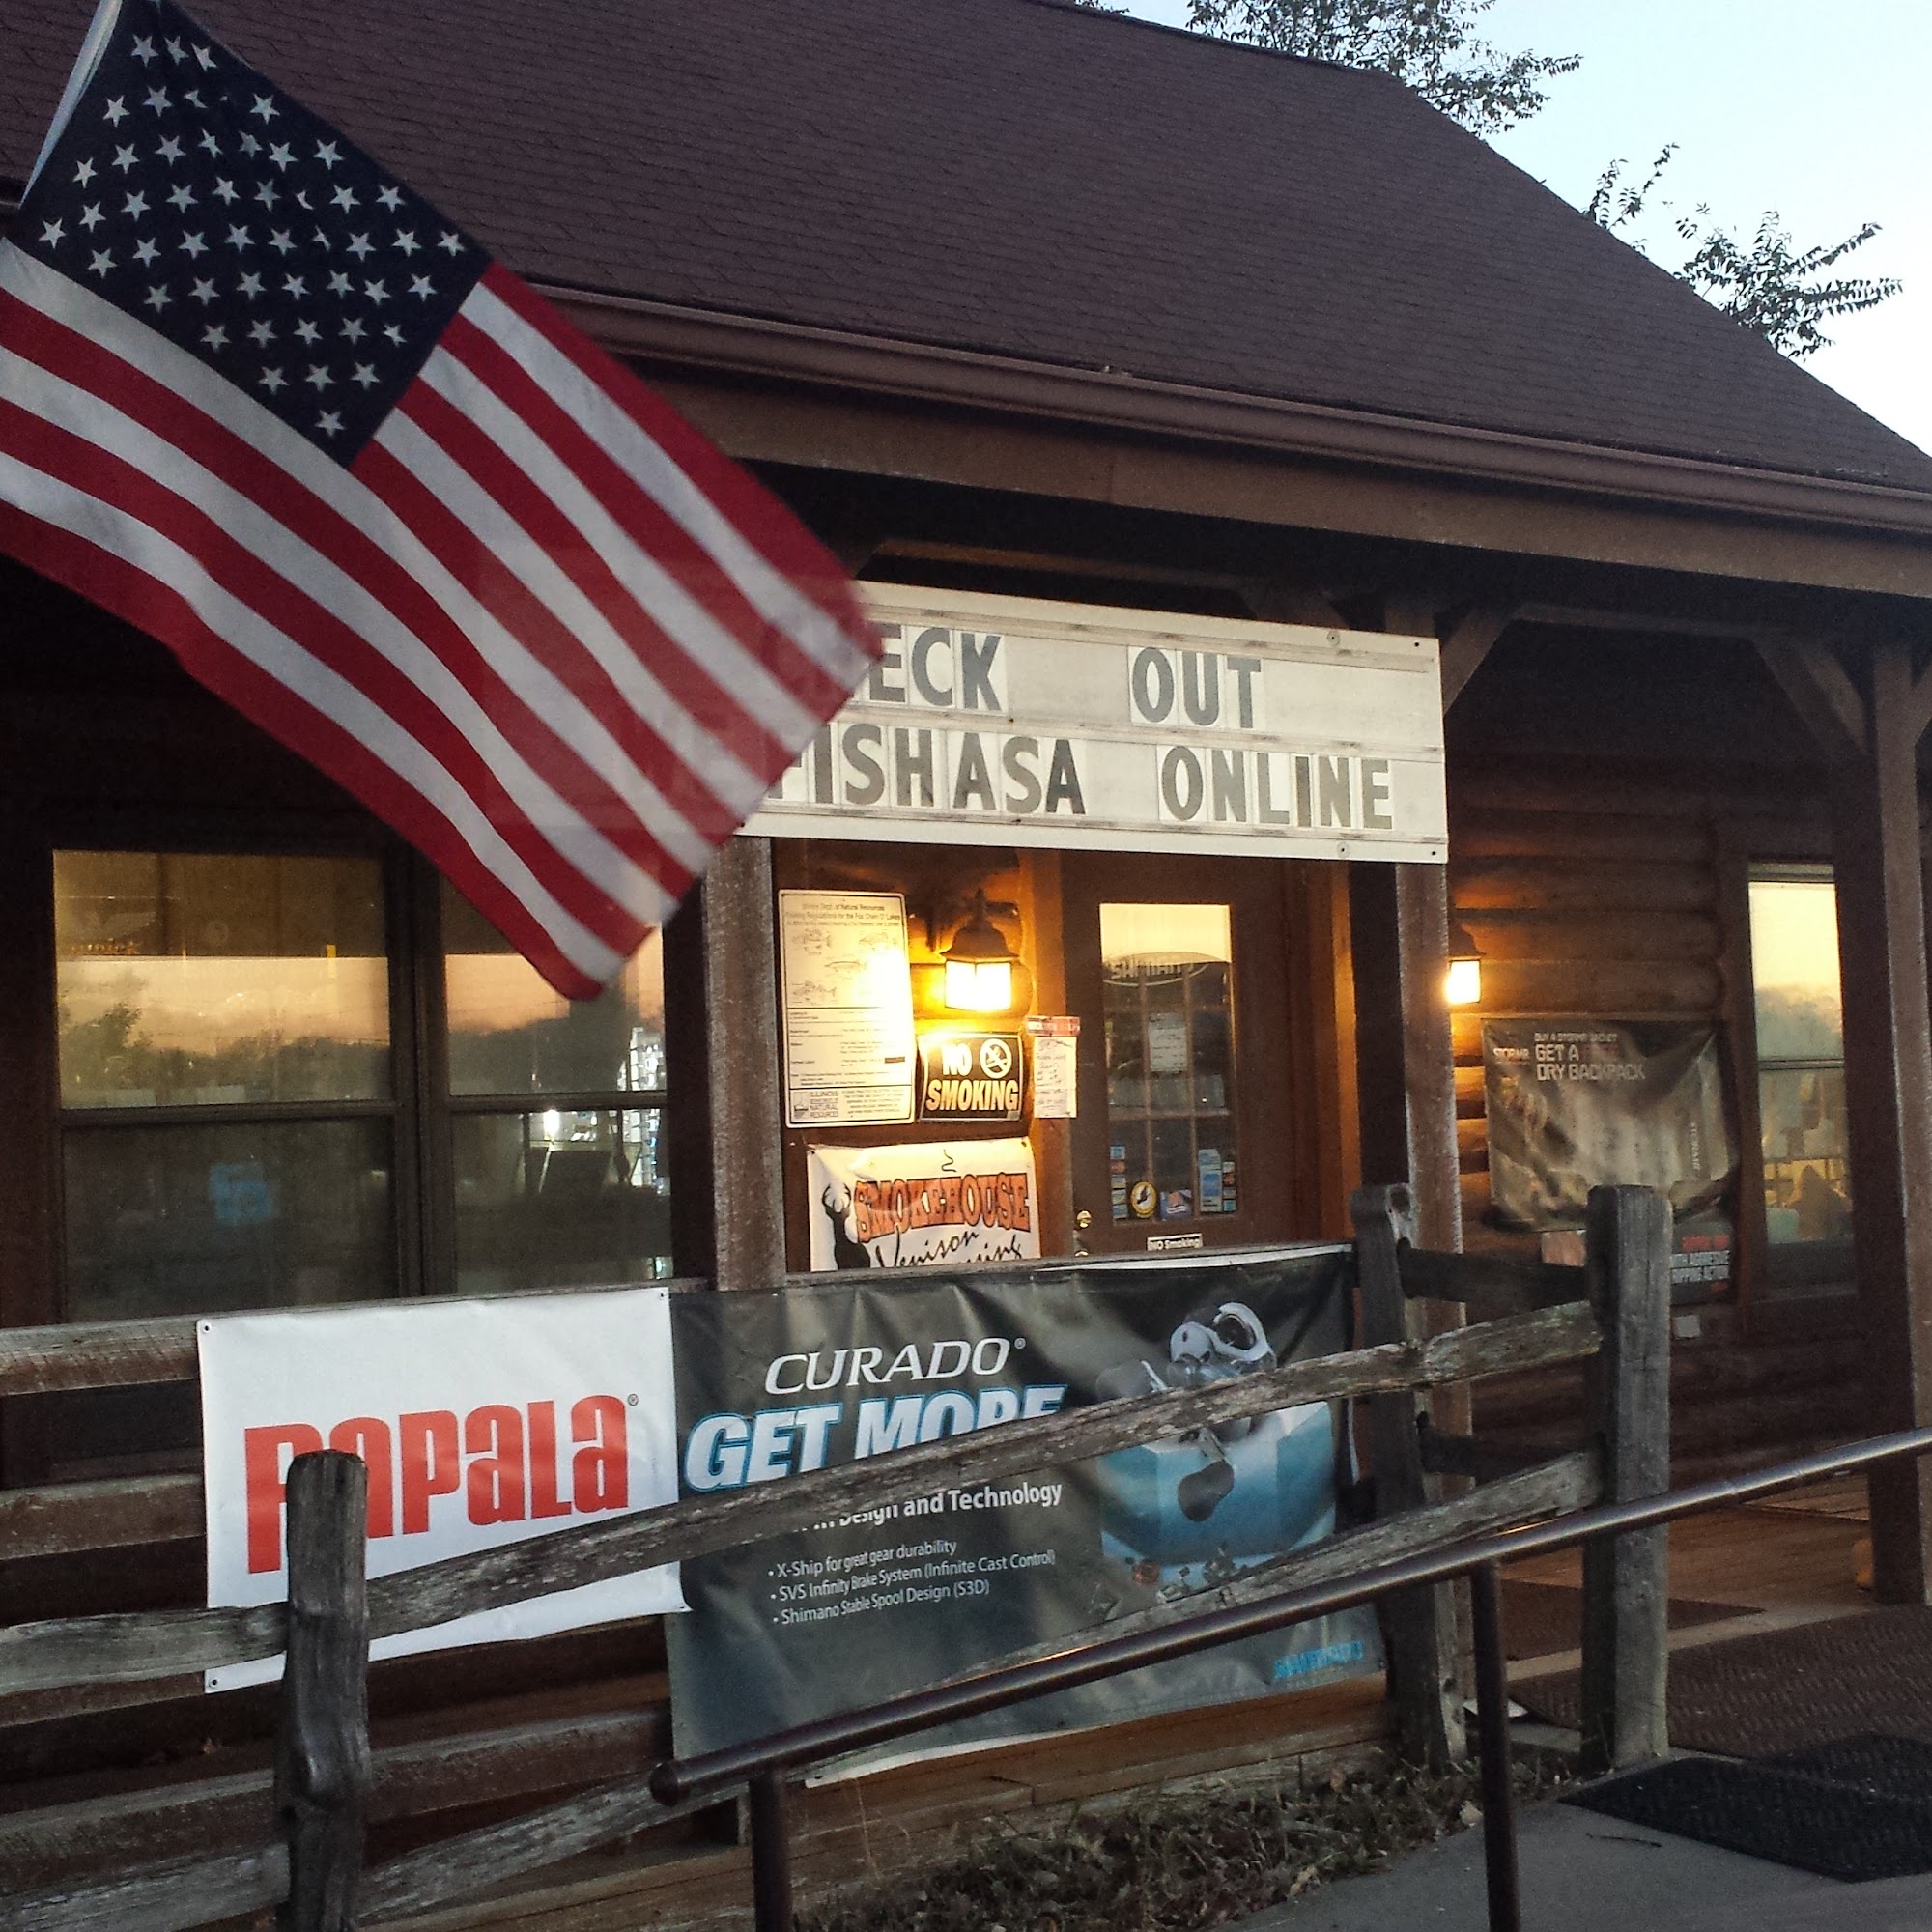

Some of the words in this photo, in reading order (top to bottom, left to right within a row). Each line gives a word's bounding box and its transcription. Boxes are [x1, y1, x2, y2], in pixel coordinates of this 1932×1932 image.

[868, 622, 1002, 712] ECK
[1132, 646, 1262, 729] OUT
[769, 722, 1086, 815] ISHASA
[1162, 746, 1393, 830] ONLINE
[942, 1041, 973, 1076] NO
[1534, 1043, 1565, 1062] GET
[1568, 1043, 1580, 1062] A
[1536, 1063, 1566, 1081] DRY
[925, 1078, 1019, 1111] SMOKING
[854, 1172, 1031, 1244] SMOKEHOUSE
[764, 1337, 1011, 1395] CURADO
[682, 1402, 843, 1493] GET
[903, 1493, 944, 1517] and
[947, 1481, 1063, 1511] Technology
[776, 1559, 824, 1579] X-Ship
[825, 1556, 843, 1572] for
[843, 1551, 869, 1572] great
[869, 1548, 895, 1568] gear
[895, 1538, 958, 1560] durability
[778, 1585, 807, 1602] SVS
[809, 1578, 851, 1598] Infinity
[851, 1572, 878, 1589] Brake
[878, 1567, 923, 1587] System
[923, 1560, 976, 1579] (Infinite
[978, 1554, 1009, 1573] Cast
[1009, 1548, 1056, 1569] Control)
[781, 1605, 839, 1626] Shimano
[840, 1598, 871, 1616] Stable
[871, 1592, 905, 1611] Spool
[906, 1584, 951, 1604] Design
[952, 1578, 990, 1600] (S3D)
